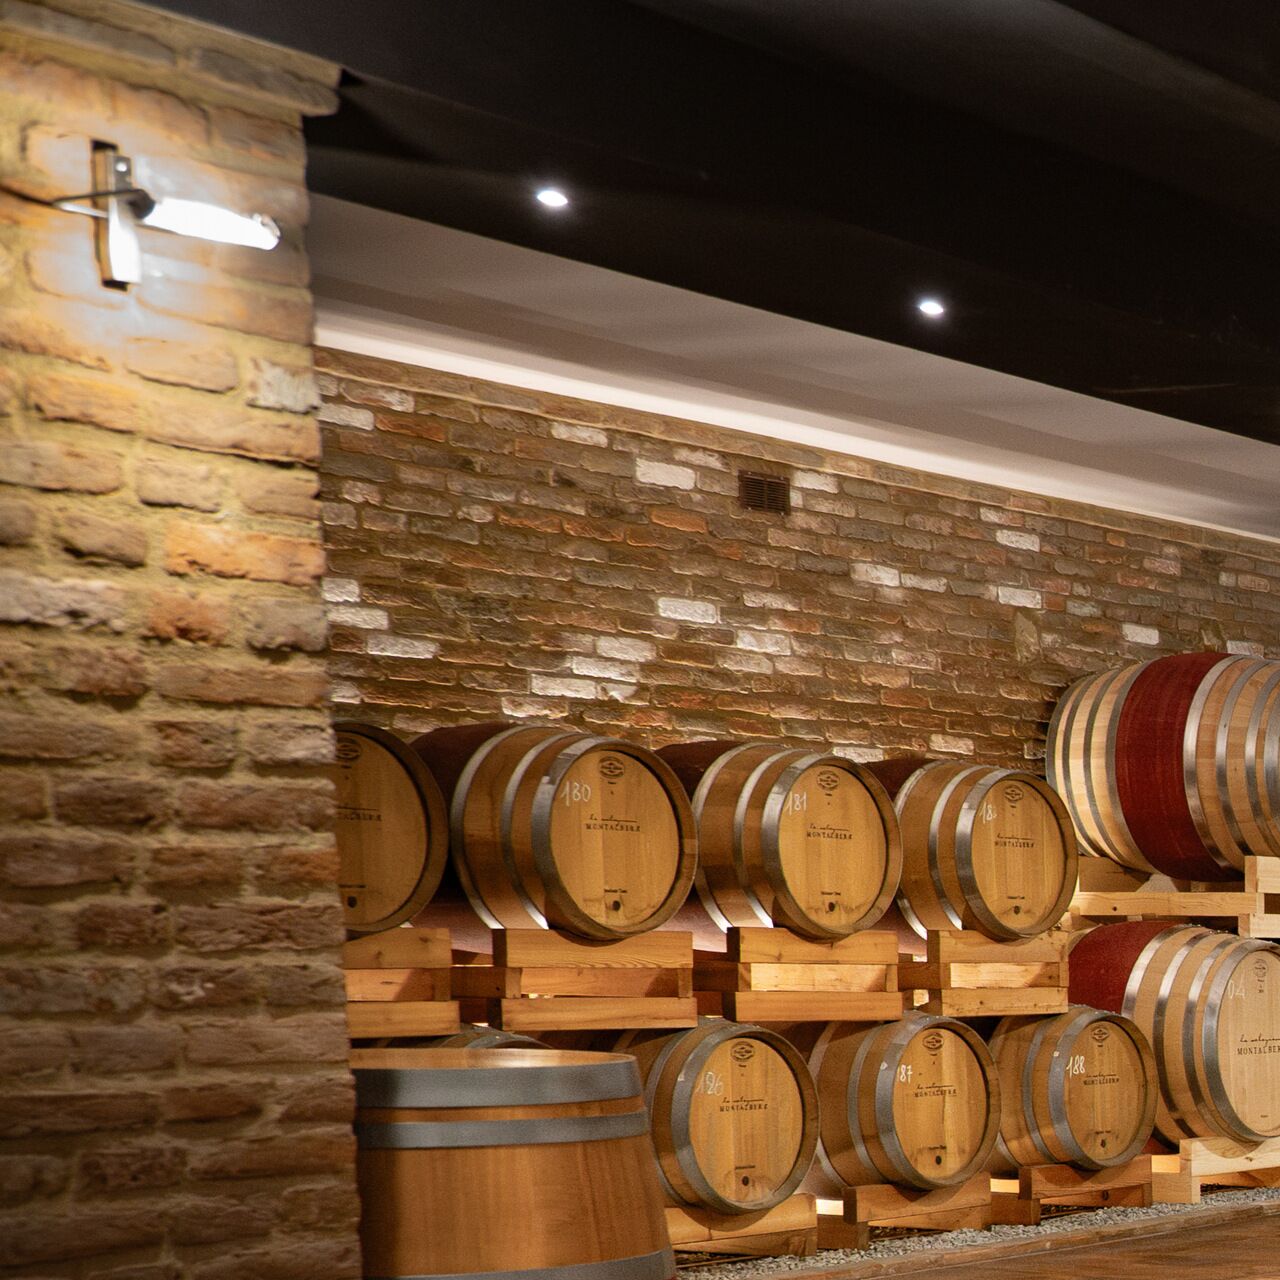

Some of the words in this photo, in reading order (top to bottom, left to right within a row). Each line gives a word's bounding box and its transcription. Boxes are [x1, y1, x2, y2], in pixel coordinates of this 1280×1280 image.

[560, 780, 592, 807] 180
[782, 791, 807, 816] 181
[1066, 1054, 1086, 1079] 188
